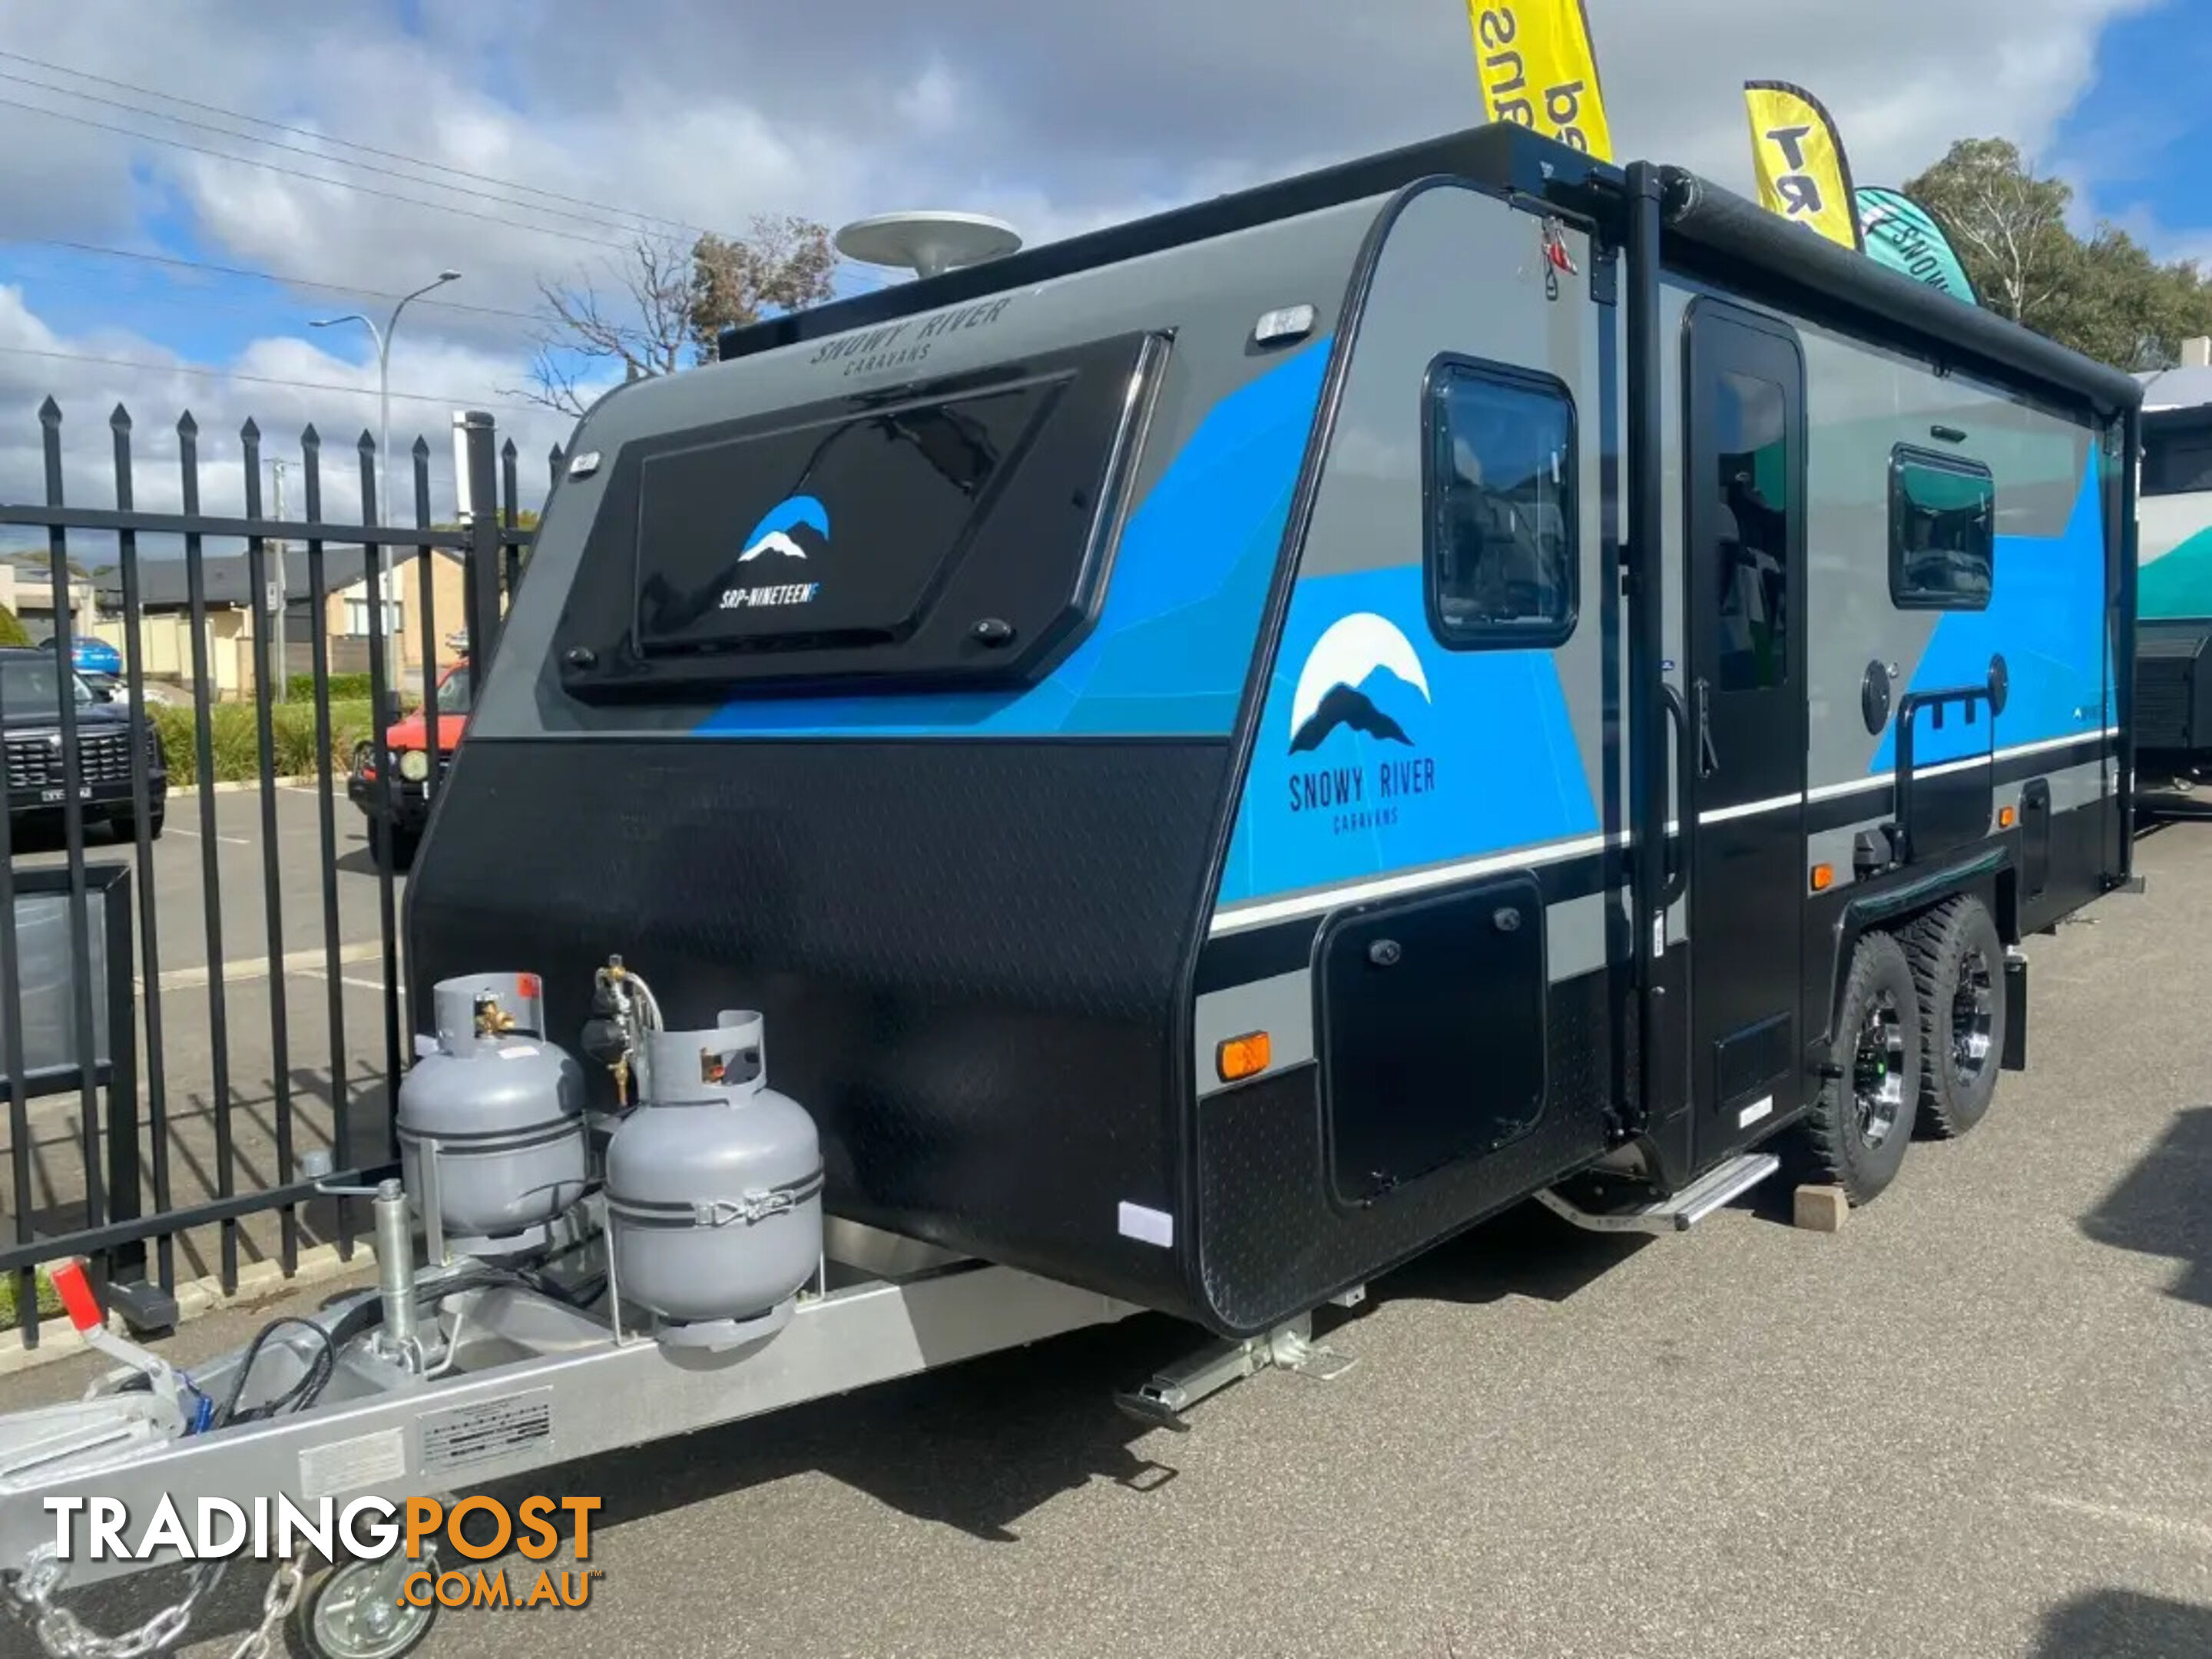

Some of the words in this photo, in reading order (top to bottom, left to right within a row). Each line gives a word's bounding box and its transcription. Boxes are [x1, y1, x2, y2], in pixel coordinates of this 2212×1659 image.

[1892, 225, 1952, 293] SNOW
[810, 323, 912, 365] SNOWY
[917, 296, 1012, 339] RIVER
[843, 343, 931, 376] CARAVANS
[1288, 766, 1363, 813] SNOWY
[1379, 757, 1435, 799] RIVER
[1333, 806, 1399, 836] CARAVANS
